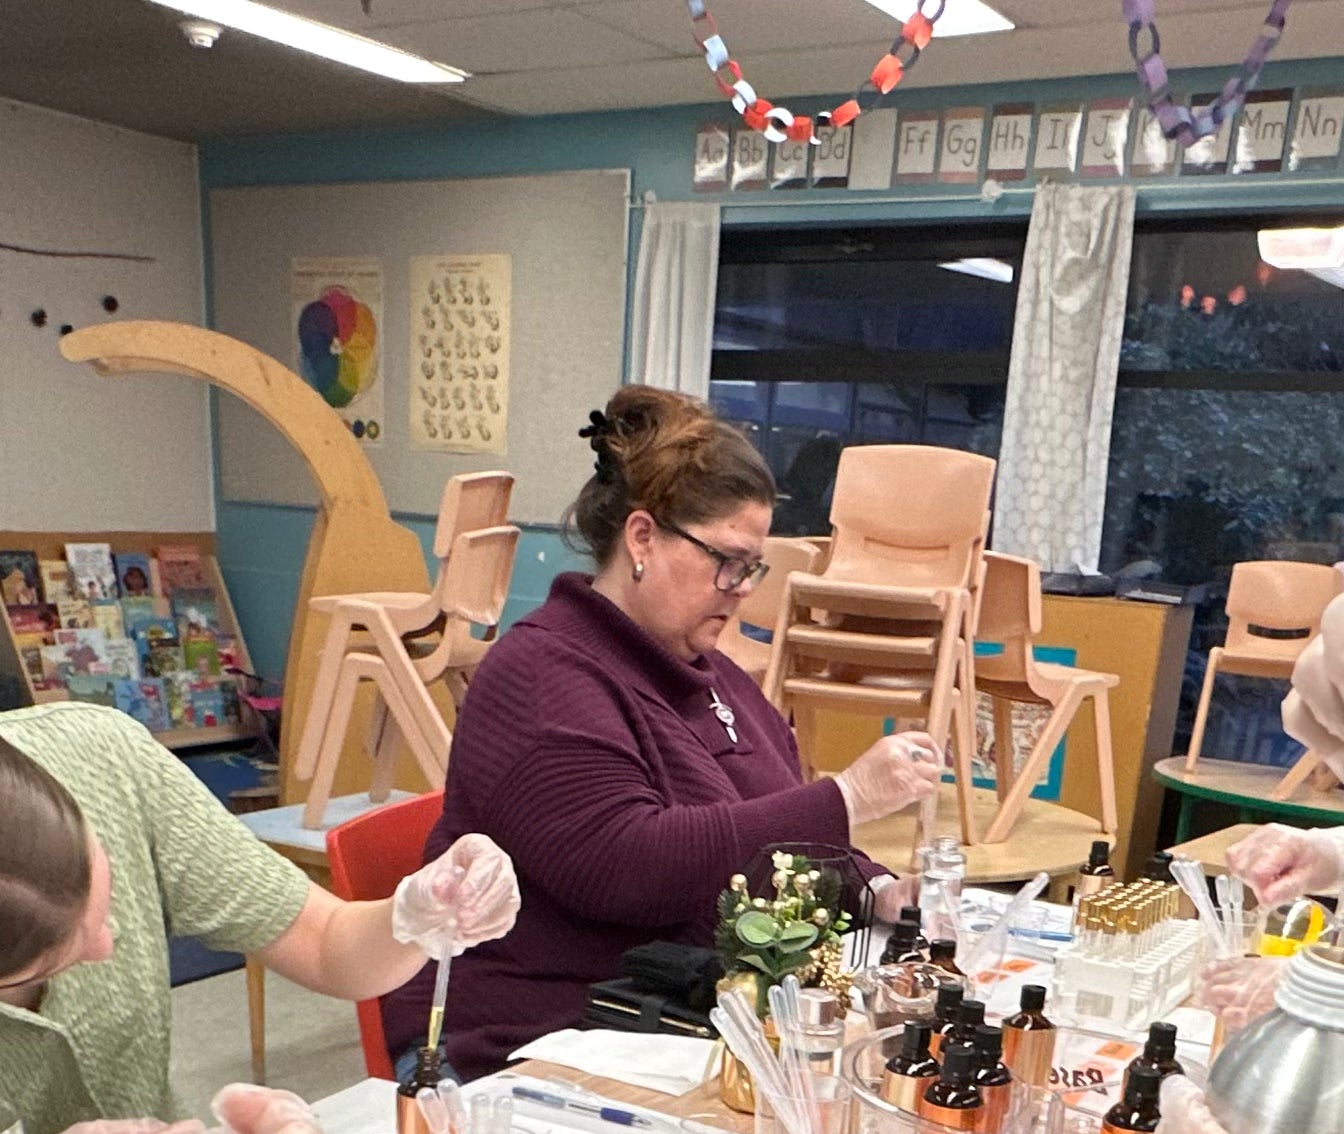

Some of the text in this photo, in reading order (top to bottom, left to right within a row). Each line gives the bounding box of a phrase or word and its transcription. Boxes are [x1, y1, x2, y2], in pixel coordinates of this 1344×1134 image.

[739, 136, 763, 164] Bb
[779, 141, 804, 162] Cc
[819, 131, 847, 160] Dd
[905, 126, 932, 155] Ff
[946, 124, 977, 167] Gg
[994, 121, 1025, 151] Hh
[1243, 109, 1285, 141] Mm
[1300, 104, 1337, 138] Nn
